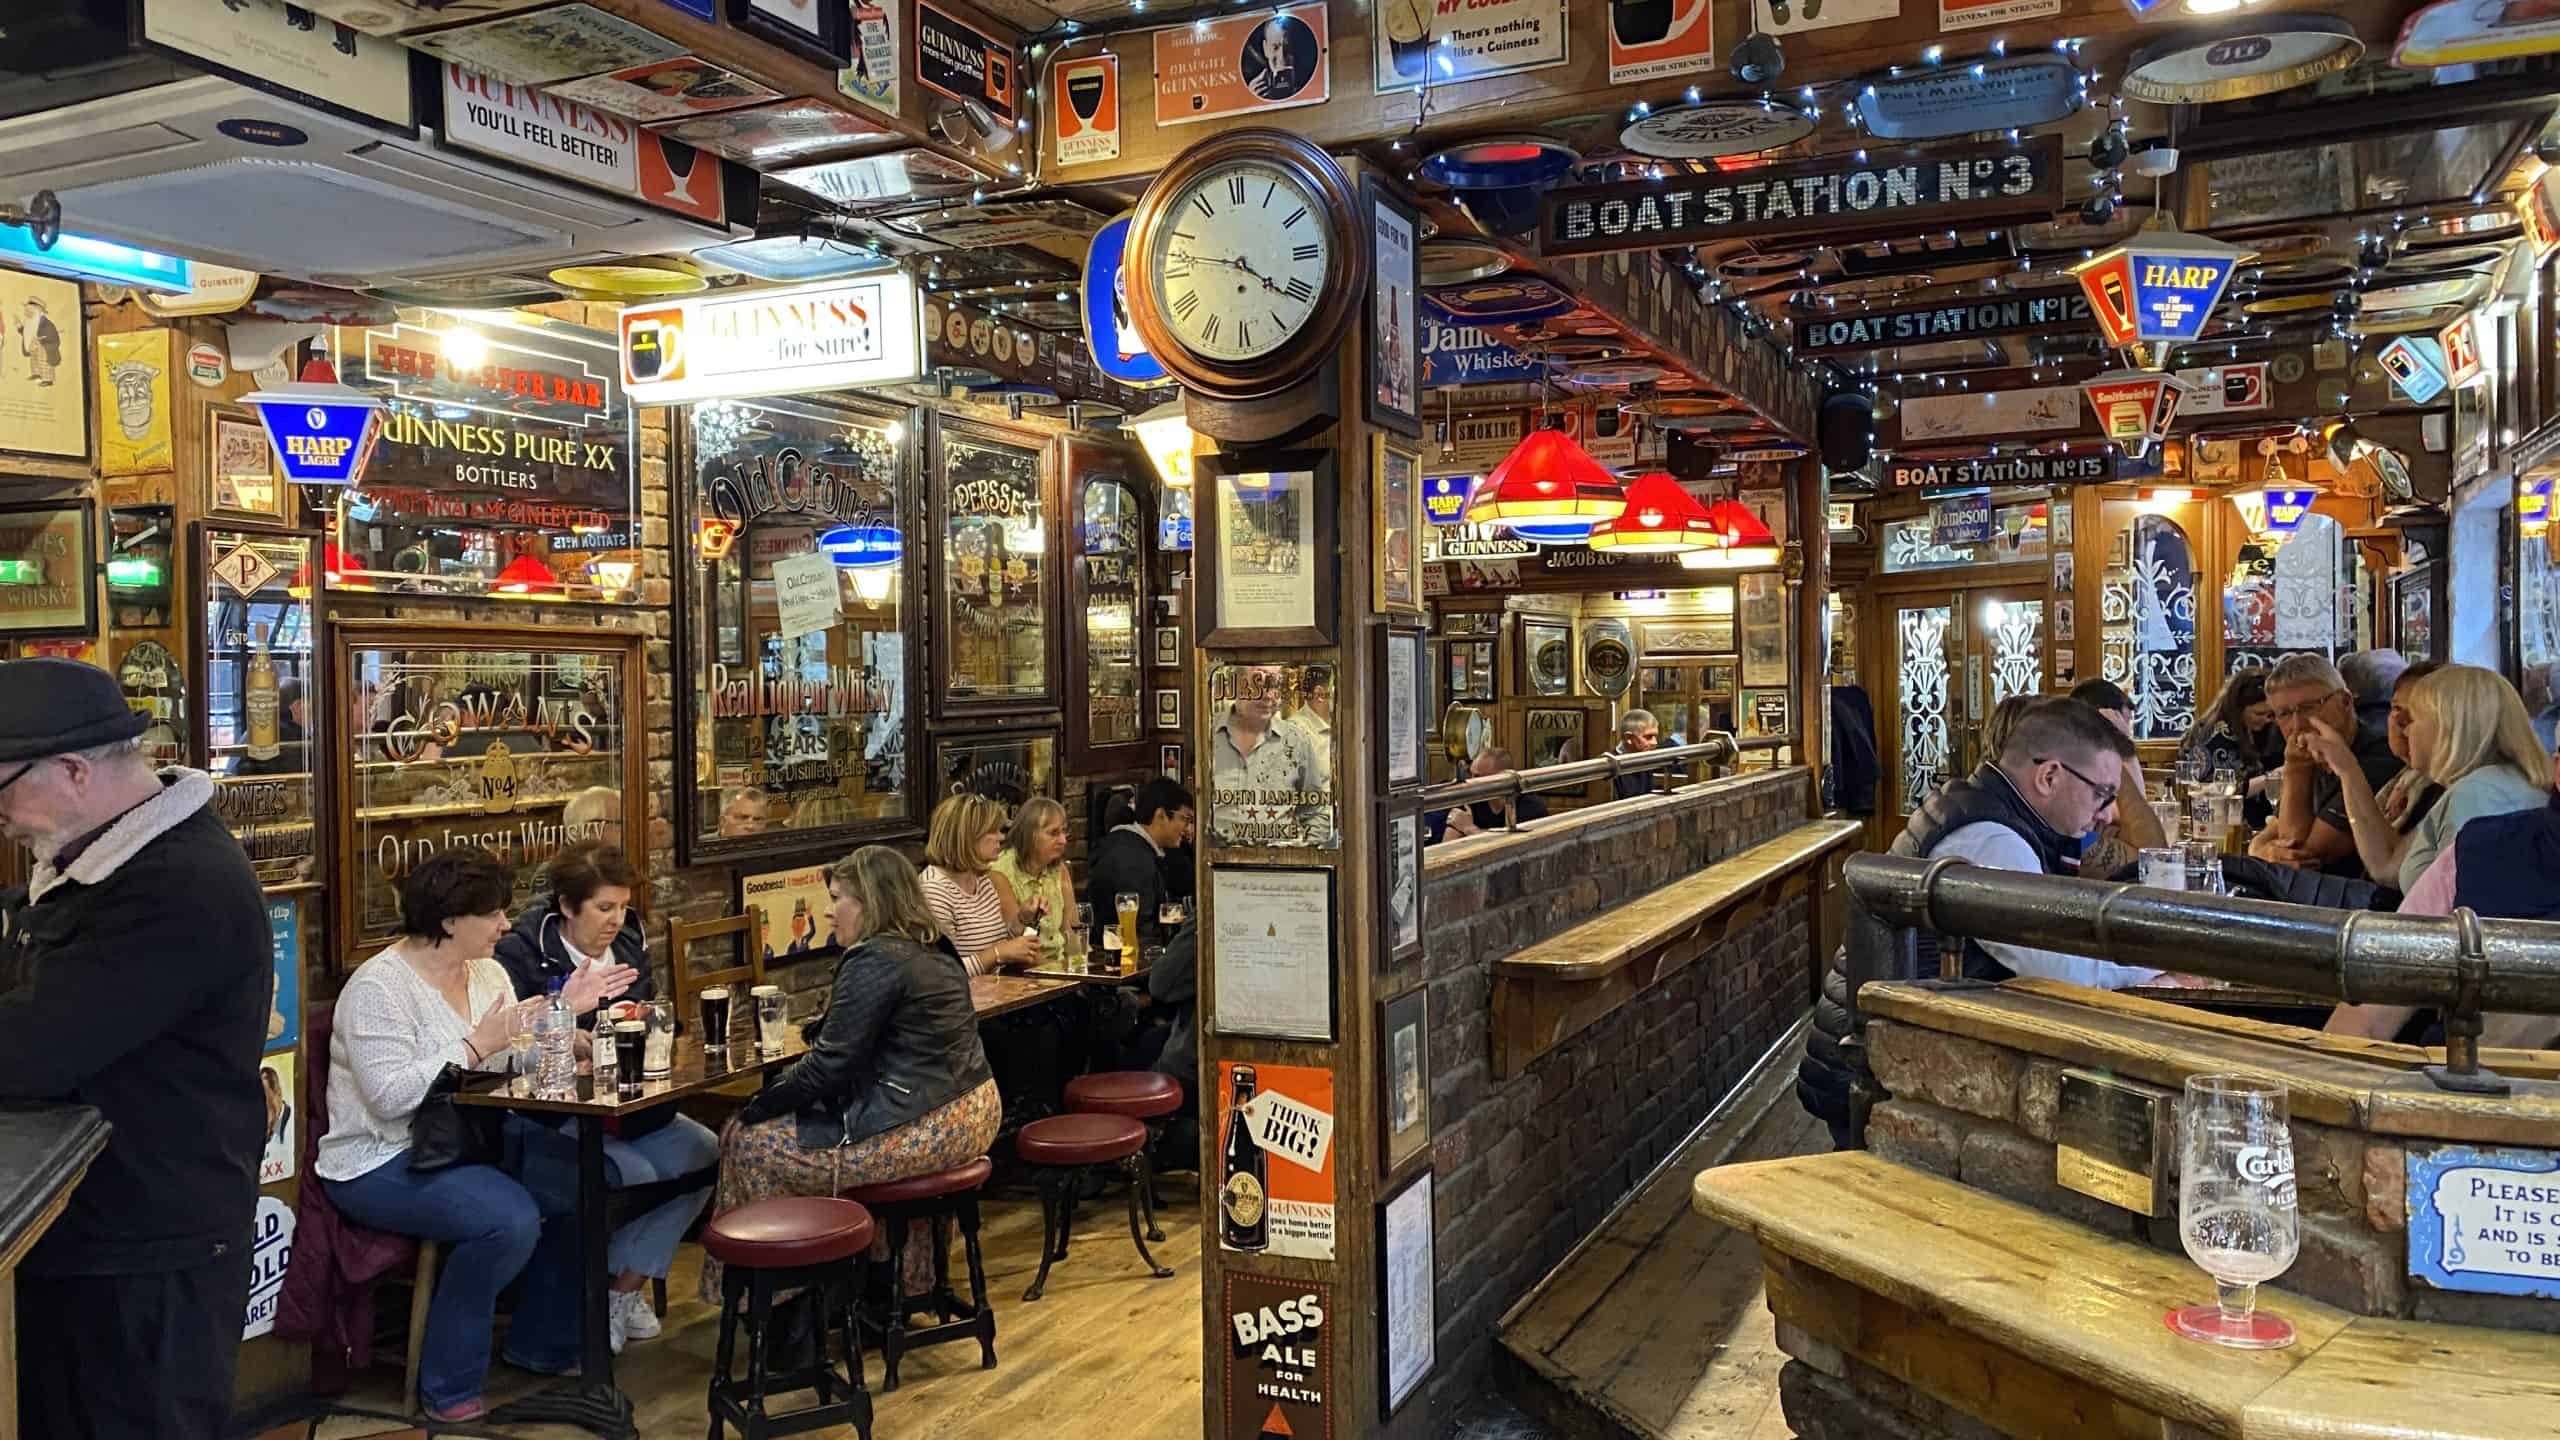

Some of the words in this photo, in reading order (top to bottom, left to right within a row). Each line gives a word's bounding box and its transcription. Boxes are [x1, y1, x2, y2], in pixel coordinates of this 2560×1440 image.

[1451, 26, 1490, 42] There's
[1493, 17, 1541, 35] nothing
[921, 24, 985, 71] GUINNESS
[922, 44, 940, 61] more
[940, 50, 954, 66] than
[1453, 45, 1475, 58] like
[1476, 46, 1484, 55] a
[1487, 35, 1541, 53] Guinness
[1168, 56, 1226, 75] DRAUGHT
[1651, 63, 1667, 73] FOR
[1668, 57, 1711, 72] STRENGTH
[1161, 70, 1237, 95] GUINNESS
[450, 62, 629, 145] GUINNESS
[466, 101, 521, 138] YOU'LL
[523, 120, 558, 150] FEEL
[560, 133, 619, 169] BETTER!
[1565, 192, 1693, 240] BOAT
[1703, 166, 1918, 225] STATION
[2142, 264, 2219, 290] HARP
[1807, 316, 1887, 347] BOAT
[1893, 306, 2021, 337] STATION
[815, 326, 870, 356] sure!
[1454, 350, 1533, 373] Whiskey
[376, 344, 437, 378] THE
[553, 378, 602, 408] BAR
[285, 435, 352, 456] HARP
[514, 431, 577, 467] PURE
[583, 442, 616, 473] XX
[299, 455, 340, 467] LAGER
[454, 463, 538, 491] BOTTLERS
[1895, 466, 1952, 487] BOAT
[1956, 460, 2046, 484] STATION
[709, 453, 777, 539] Old
[1933, 506, 1989, 529] Jameson
[1447, 539, 1529, 555] GUINNESS
[1546, 551, 1597, 569] JACOB
[8, 586, 69, 607] WHISKY
[711, 662, 755, 717] Real
[758, 661, 832, 722] Liqueur
[832, 662, 896, 721] Whisky
[771, 734, 828, 757] YEARS
[215, 782, 287, 818] POWER'S
[1213, 789, 1256, 806] JOHN
[1258, 789, 1332, 806] JAMESON
[1231, 822, 1312, 840] WHISKEY
[746, 877, 786, 895] Goodness!
[1269, 1100, 1321, 1136] THINK
[1262, 1117, 1318, 1159] BIG!
[2470, 1177, 2560, 1204] PLEASE
[1269, 1201, 1332, 1219] GUINNESS
[2495, 1204, 2516, 1223] IT
[2522, 1211, 2542, 1225] IS
[1270, 1217, 1286, 1227] goes
[1288, 1216, 1308, 1228] home
[1309, 1219, 1332, 1230] better
[1284, 1226, 1306, 1239] bigger
[1307, 1228, 1332, 1241] bottle!
[2478, 1227, 2519, 1243] AND
[2527, 1232, 2546, 1246] IS
[2505, 1248, 2531, 1264] TO
[1231, 1294, 1324, 1347] BASS
[1260, 1343, 1317, 1369] ALE
[1275, 1369, 1304, 1383] FOR
[1257, 1382, 1322, 1403] HEALTH
